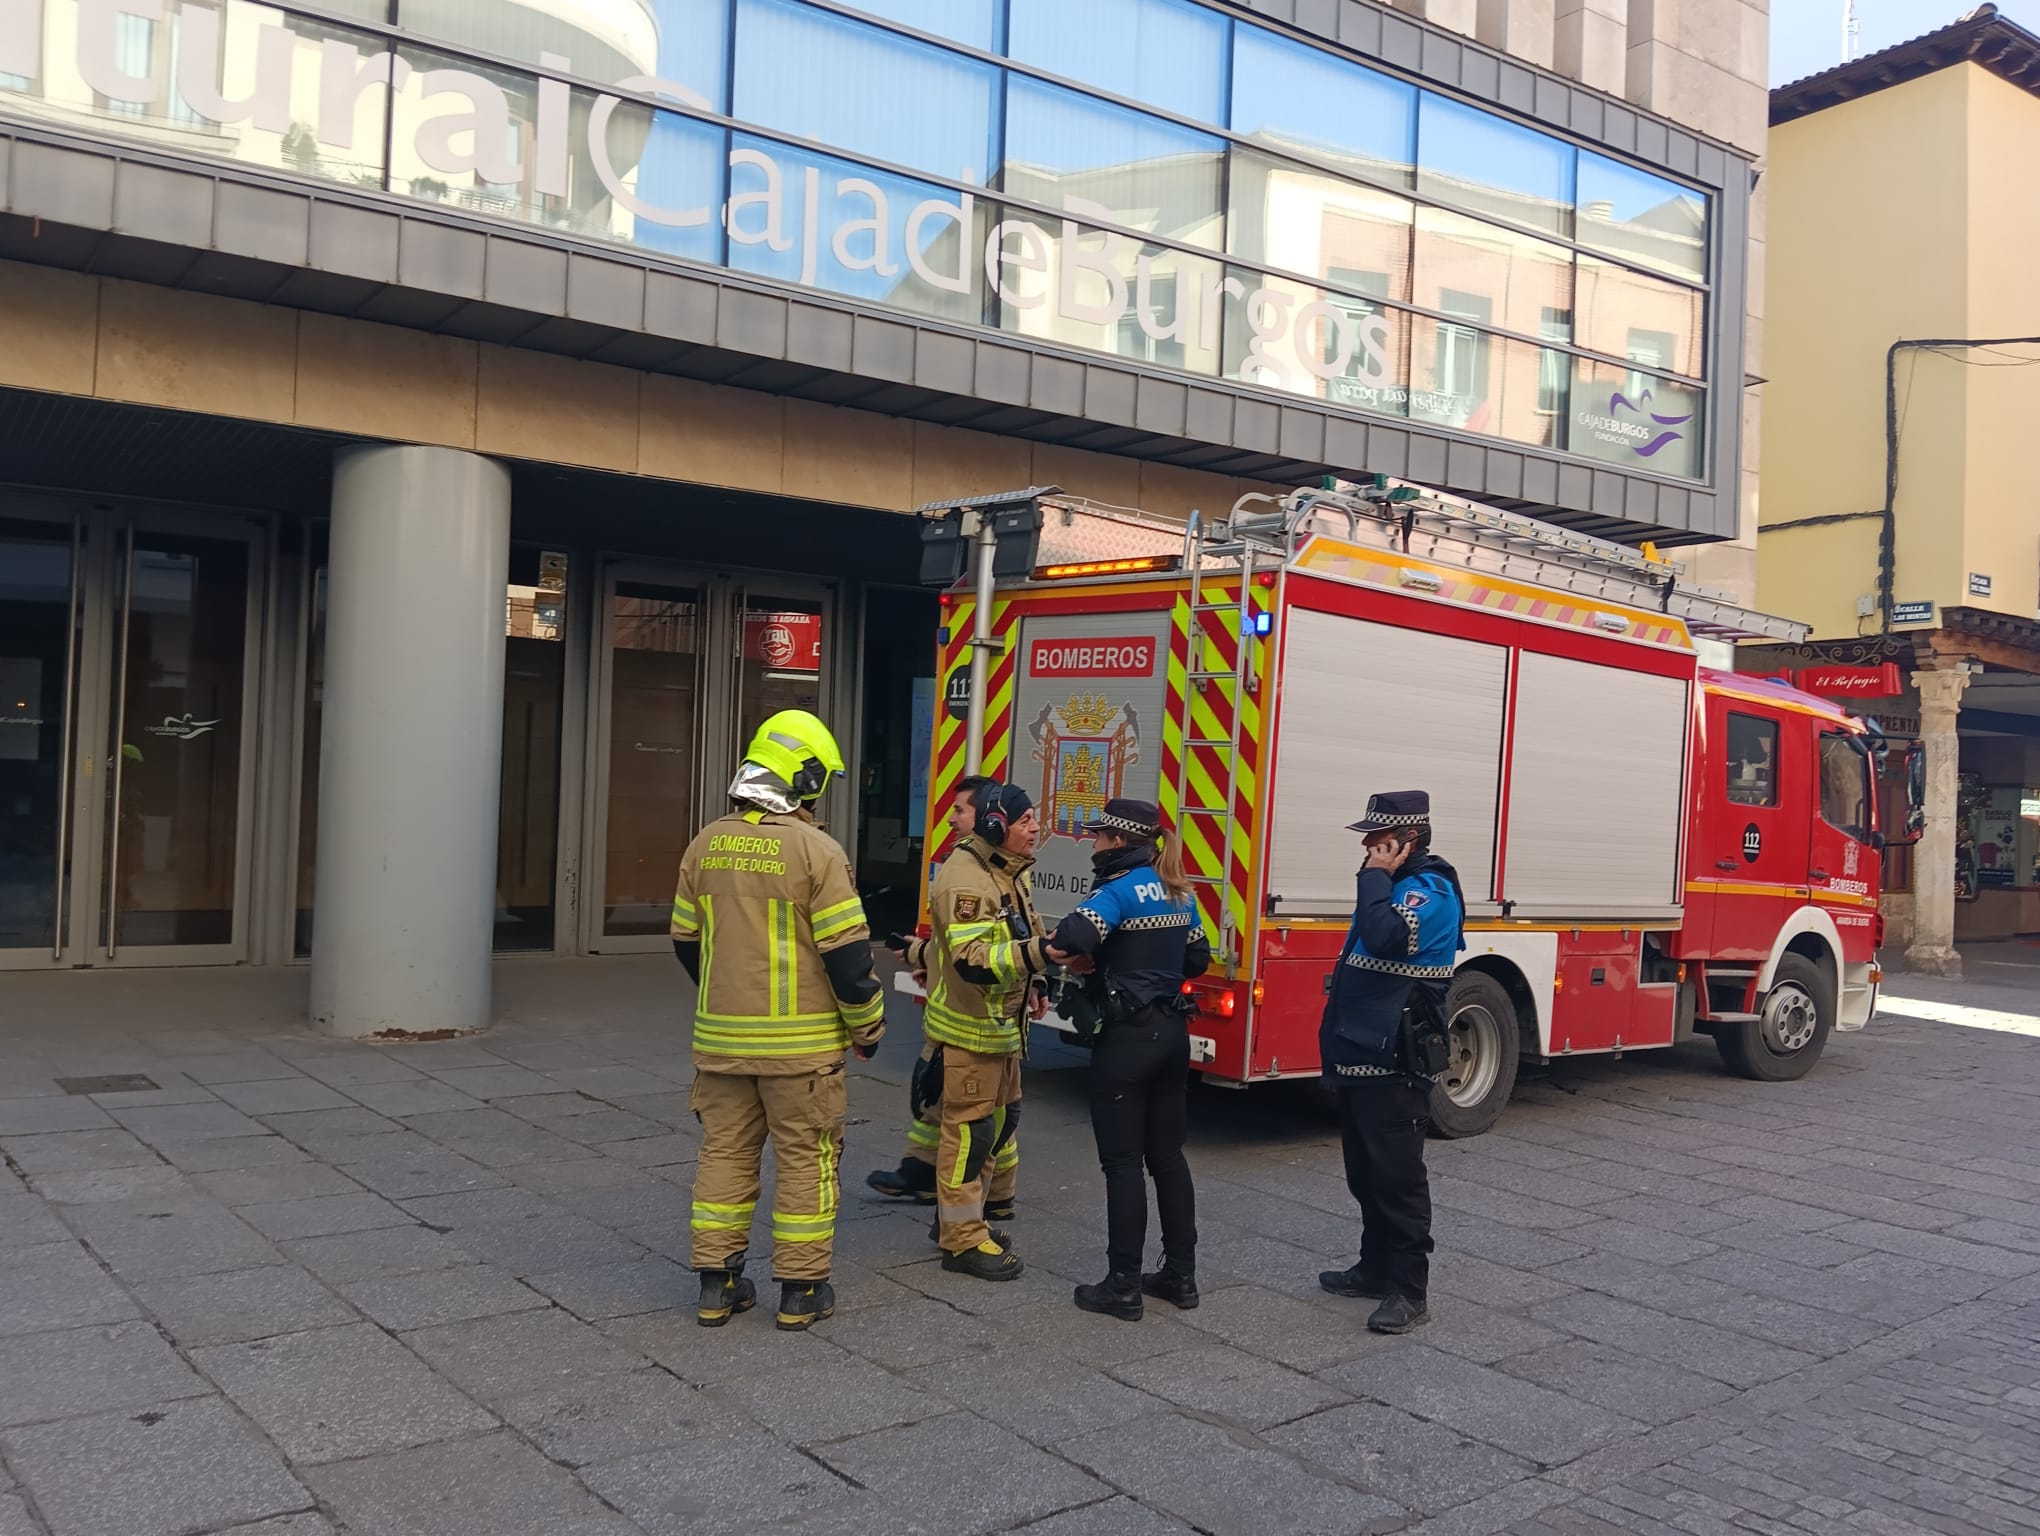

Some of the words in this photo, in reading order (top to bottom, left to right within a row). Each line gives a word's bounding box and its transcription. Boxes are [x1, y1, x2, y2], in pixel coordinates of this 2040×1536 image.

[1578, 412, 1649, 439] CAJADEBURGOS
[1035, 646, 1149, 670] BOMBEROS
[1831, 675, 1880, 689] Refugio
[708, 834, 781, 856] BOMBEROS
[1744, 832, 1760, 848] 112
[734, 858, 749, 871] DE
[749, 858, 786, 875] DUERO
[1030, 870, 1065, 891] ANDA
[1070, 876, 1089, 895] DE
[1830, 877, 1868, 894] BOMBEROS
